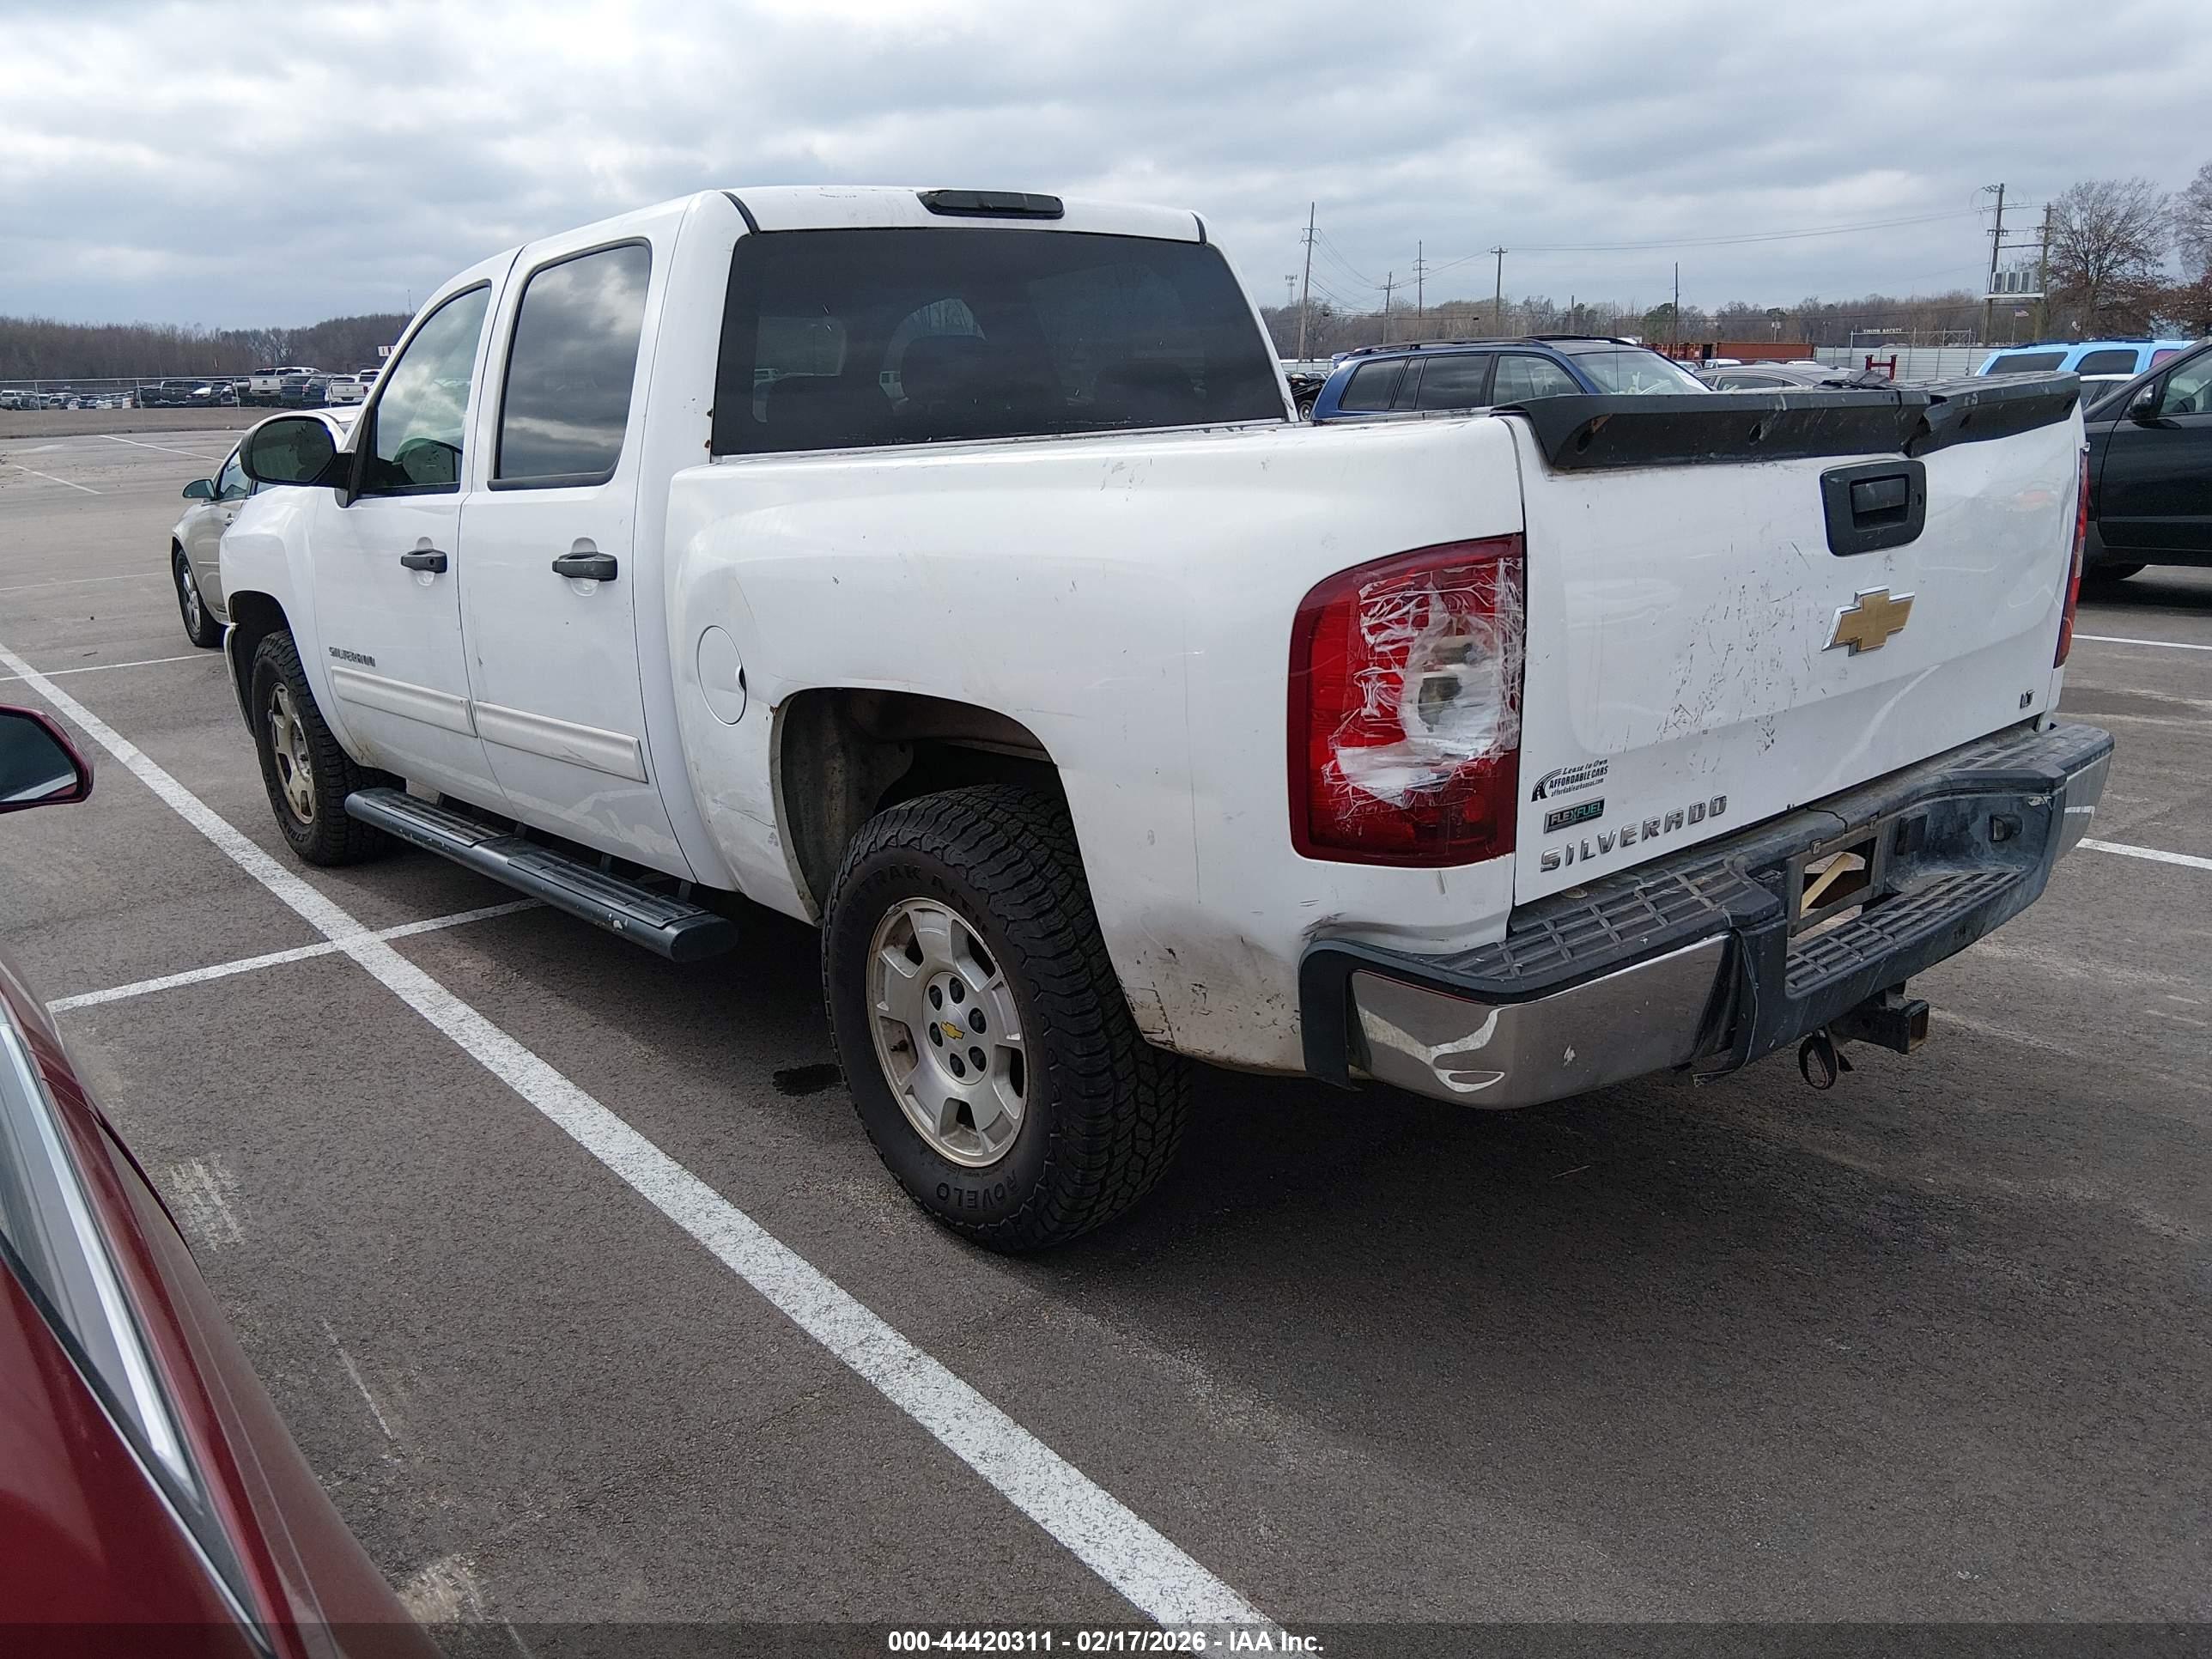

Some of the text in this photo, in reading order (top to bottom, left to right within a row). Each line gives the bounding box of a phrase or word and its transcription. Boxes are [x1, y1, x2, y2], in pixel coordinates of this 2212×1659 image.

[1548, 766, 1608, 790] AFFORDABLE CARS
[1562, 765, 1584, 775] Lease
[1593, 758, 1608, 768] Own
[1550, 801, 1603, 825] FLEXFUEL
[1540, 793, 1728, 872] SILVERADO
[936, 1169, 1020, 1210] ROVELO
